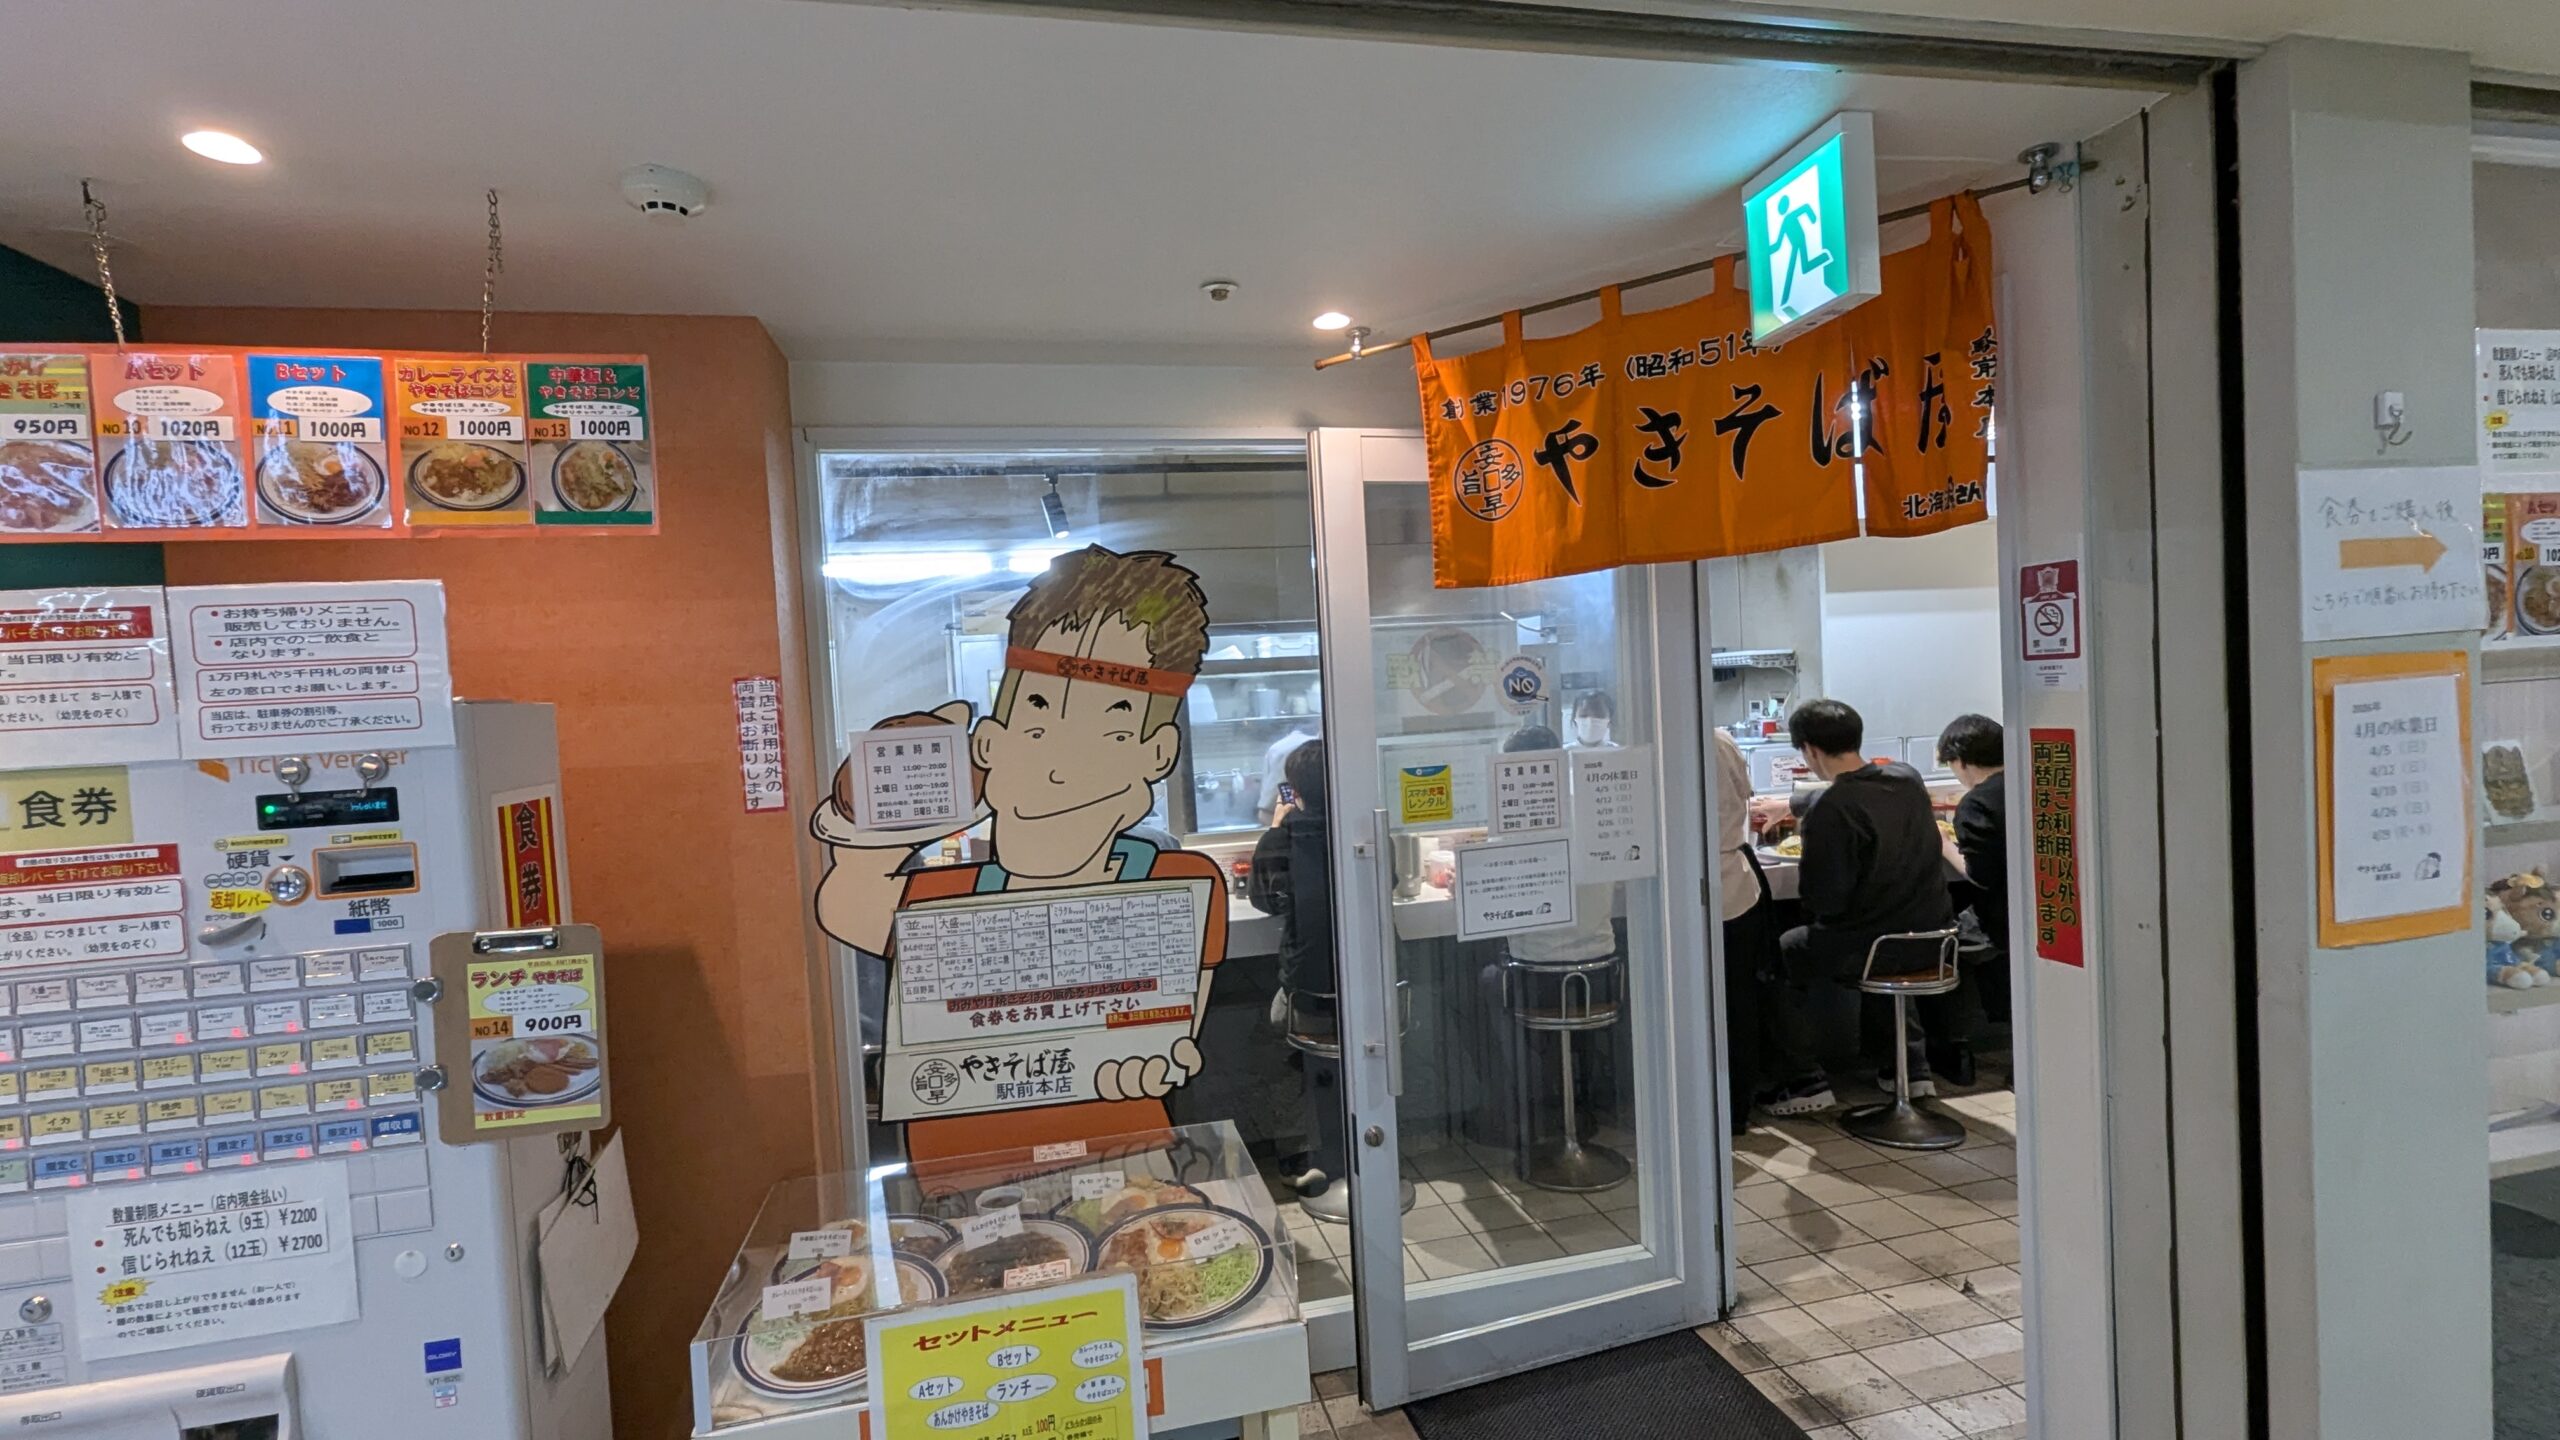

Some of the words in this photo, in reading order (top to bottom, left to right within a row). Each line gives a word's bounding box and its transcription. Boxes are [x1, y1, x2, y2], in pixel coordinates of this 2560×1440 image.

[125, 361, 206, 380] Aセット
[276, 362, 347, 382] Bセット
[399, 367, 517, 384] カレーライス&
[408, 383, 517, 399] やきそばコンビ
[538, 385, 640, 399] やきそばコンビ
[1441, 363, 1605, 419] 創業1976年
[14, 419, 78, 434] 950円
[102, 424, 120, 434] NO
[161, 420, 220, 436] 1020円
[310, 421, 366, 437] 1000円
[404, 425, 420, 436] NO
[423, 422, 439, 436] 12
[459, 420, 512, 436] 1000円
[534, 427, 549, 437] NO
[551, 423, 566, 437] 13
[581, 420, 630, 436] 1000円
[223, 606, 390, 619] お持ち帰りメニュー
[224, 616, 400, 632] 販売しておりません。
[229, 632, 380, 648] 店内でのご飲食と
[7, 651, 141, 666] 当日限り有効と
[231, 648, 316, 660] なります。
[208, 664, 406, 682] 1万円札や5千円札の両替は
[1080, 664, 1150, 686] やきそば屋
[91, 690, 142, 701] お一人様で
[209, 681, 398, 697] 左の窓口でお願いします。
[211, 705, 343, 721] 当店は、駐車券の割引等、
[211, 714, 412, 734] 行っておりませんのでご了承ください。
[2355, 717, 2438, 738] 4月の休業日
[757, 680, 782, 793] 当店ご利用以外の
[738, 681, 763, 810] 両替はお断りします
[876, 742, 941, 758] 営業時間
[2369, 744, 2392, 757] 4/5
[873, 765, 892, 775] 平日
[1504, 764, 1550, 778] 営業時間
[1586, 770, 1638, 783] 4月の休業日
[874, 783, 898, 794] 土曜日
[1408, 786, 1445, 798] スマホ充電
[1501, 783, 1514, 791] 平日
[18, 787, 118, 829] 食券
[1408, 797, 1446, 809] レンタル
[1501, 799, 1519, 807] 土曜日
[877, 809, 902, 820] 定休日
[913, 804, 950, 817] 日曜日・祝日
[1503, 820, 1521, 829] 定休日
[2053, 742, 2077, 926] 当店ご利用以外の
[2032, 741, 2056, 945] 両替はお断りします
[226, 850, 271, 870] 硬貨
[211, 890, 272, 909] 返却レバー
[348, 897, 391, 917] 紙幣
[119, 920, 171, 932] お一人様で
[377, 919, 399, 928] 1000
[904, 920, 920, 931] 並
[939, 917, 960, 930] 大盛
[905, 963, 934, 975] たまご
[471, 968, 528, 989] ランチ
[532, 967, 584, 985] やきそば
[945, 981, 974, 990] イカ
[983, 976, 1011, 987] エビ
[1020, 973, 1049, 983] 焼肉
[905, 985, 935, 995] 五目野菜
[969, 997, 1141, 1028] 食券をお買上げ下さい
[475, 1026, 490, 1036] NO
[493, 1021, 509, 1035] 14
[525, 1014, 582, 1032] 900円
[960, 1048, 1076, 1083] やきそば屋
[996, 1075, 1073, 1100] 駅前本店
[47, 1116, 71, 1126] イカ
[104, 1110, 127, 1120] エビ
[484, 1110, 526, 1122] 数量限定
[327, 1126, 358, 1137] 限定H
[378, 1119, 412, 1132] 領収書
[217, 1139, 247, 1151] 限定F
[273, 1133, 303, 1143] 限定G
[104, 1153, 136, 1165] 限定D
[161, 1145, 192, 1157] 限定E
[46, 1159, 78, 1171] 限定C
[123, 1209, 270, 1247] 死んでも知らねえ（9玉）
[279, 1207, 317, 1226] ￥2200
[121, 1238, 268, 1276] 信じられねえ（12玉）
[281, 1234, 323, 1252] ￥2700
[913, 1311, 1098, 1351] セットメニュー
[997, 1345, 1032, 1367] Bセット
[918, 1377, 954, 1398] Aセット
[997, 1380, 1032, 1399] ランチ
[932, 1402, 990, 1427] あんかけやきそば
[1036, 1414, 1056, 1433] 100円
